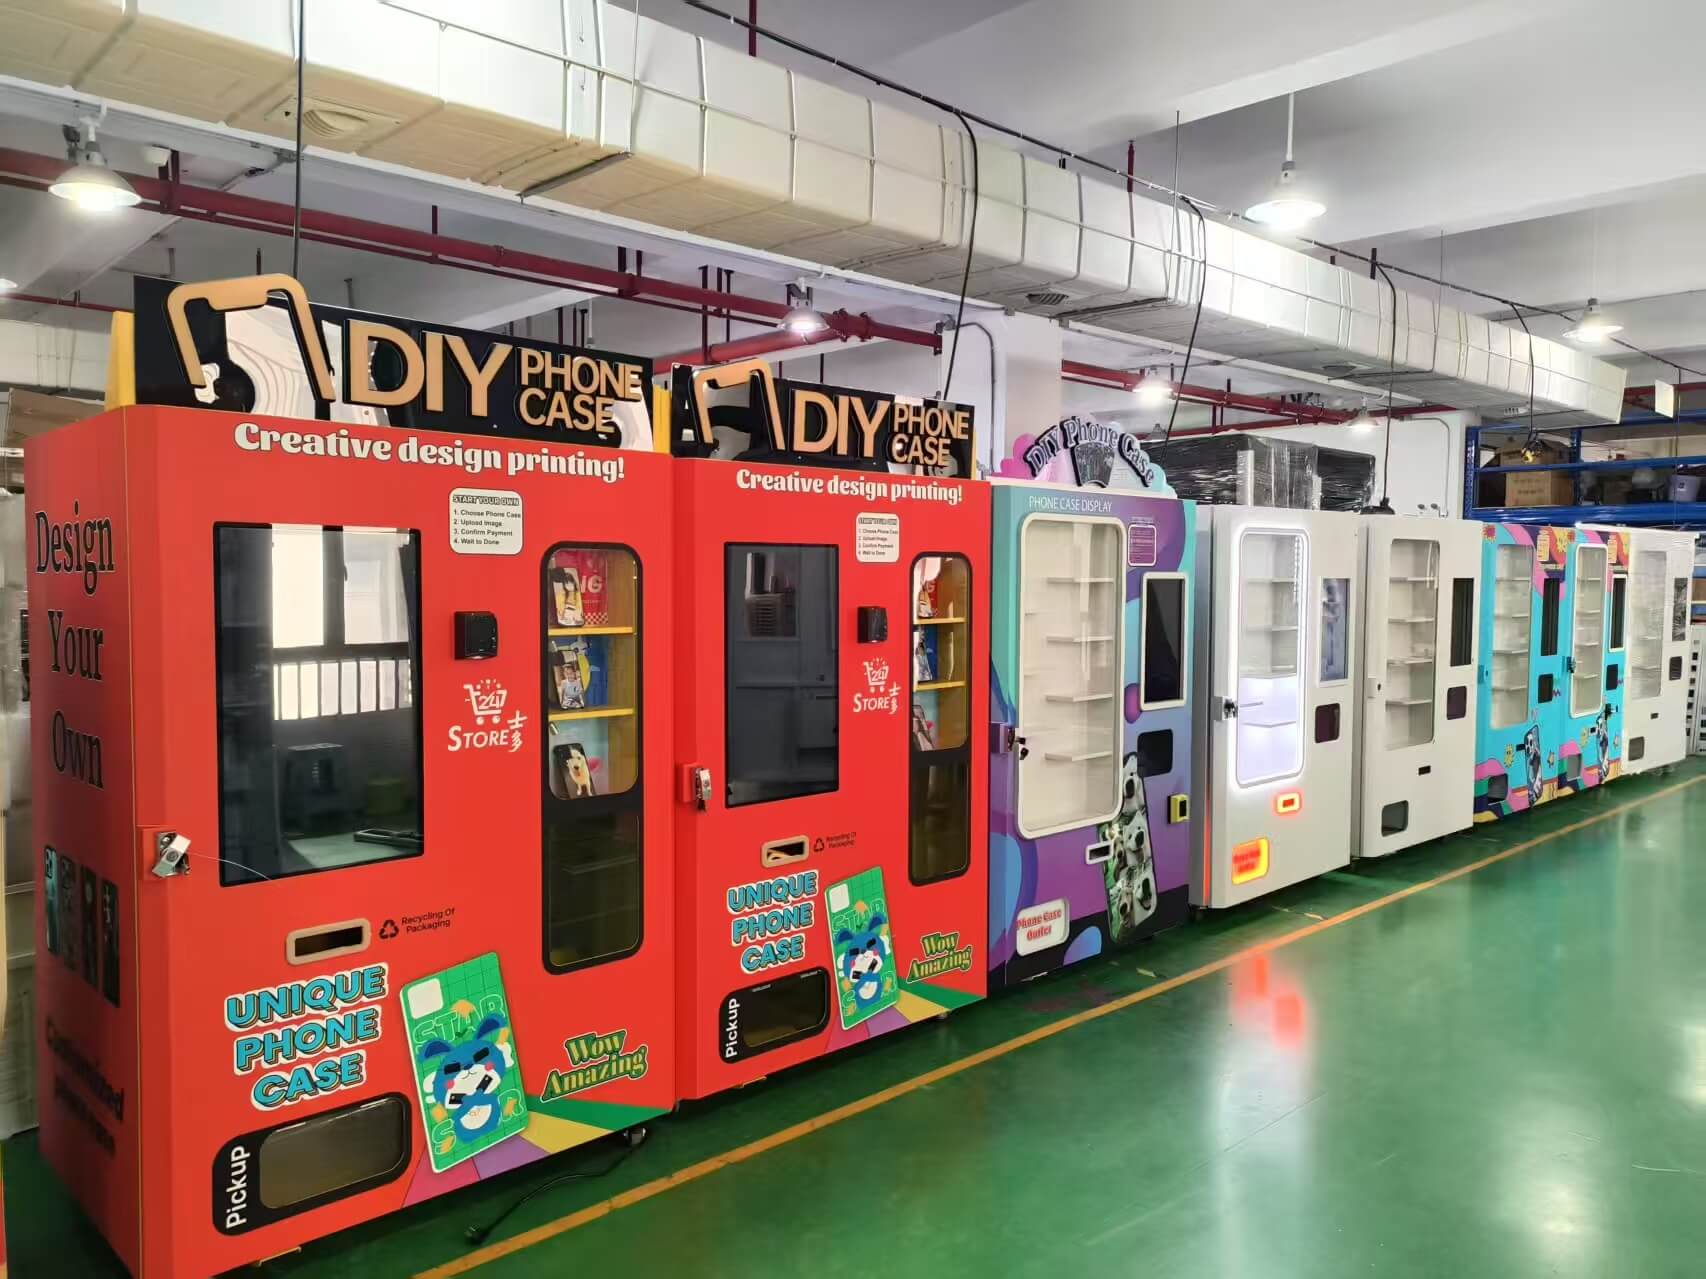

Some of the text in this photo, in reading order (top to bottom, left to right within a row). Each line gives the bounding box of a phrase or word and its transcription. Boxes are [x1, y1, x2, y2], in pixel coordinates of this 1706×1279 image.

[347, 319, 513, 417] DIY
[518, 347, 643, 400] PHONE
[518, 387, 615, 433] CASE
[793, 389, 891, 457] DIY
[893, 402, 970, 440] PHONE
[234, 423, 624, 483] Creative design printing!
[892, 433, 951, 466] CASE
[1024, 416, 1154, 487] DIY Phone Case
[478, 496, 500, 505] YOUR
[501, 497, 520, 506] OWN
[736, 469, 962, 505] Creative design printing!
[1029, 496, 1112, 512] PHONE CASE DISPLAY
[485, 510, 505, 518] Phone
[35, 500, 114, 594] Design
[48, 610, 104, 680] Your
[52, 710, 104, 789] Own
[444, 907, 455, 916] Of
[727, 871, 818, 912] UNIQUE
[406, 919, 451, 933] Packaging
[732, 903, 814, 944] PHONE
[921, 933, 959, 957] Wow
[741, 935, 805, 972] CASE
[907, 945, 972, 983] Amazing
[226, 965, 387, 1029] UNIQUE
[236, 1008, 379, 1071] PHONE
[566, 1031, 624, 1065] Wow
[725, 998, 740, 1058] Pickup
[253, 1052, 363, 1107] CASE
[542, 1046, 647, 1101] Amazing
[226, 1146, 250, 1229] Pickup
